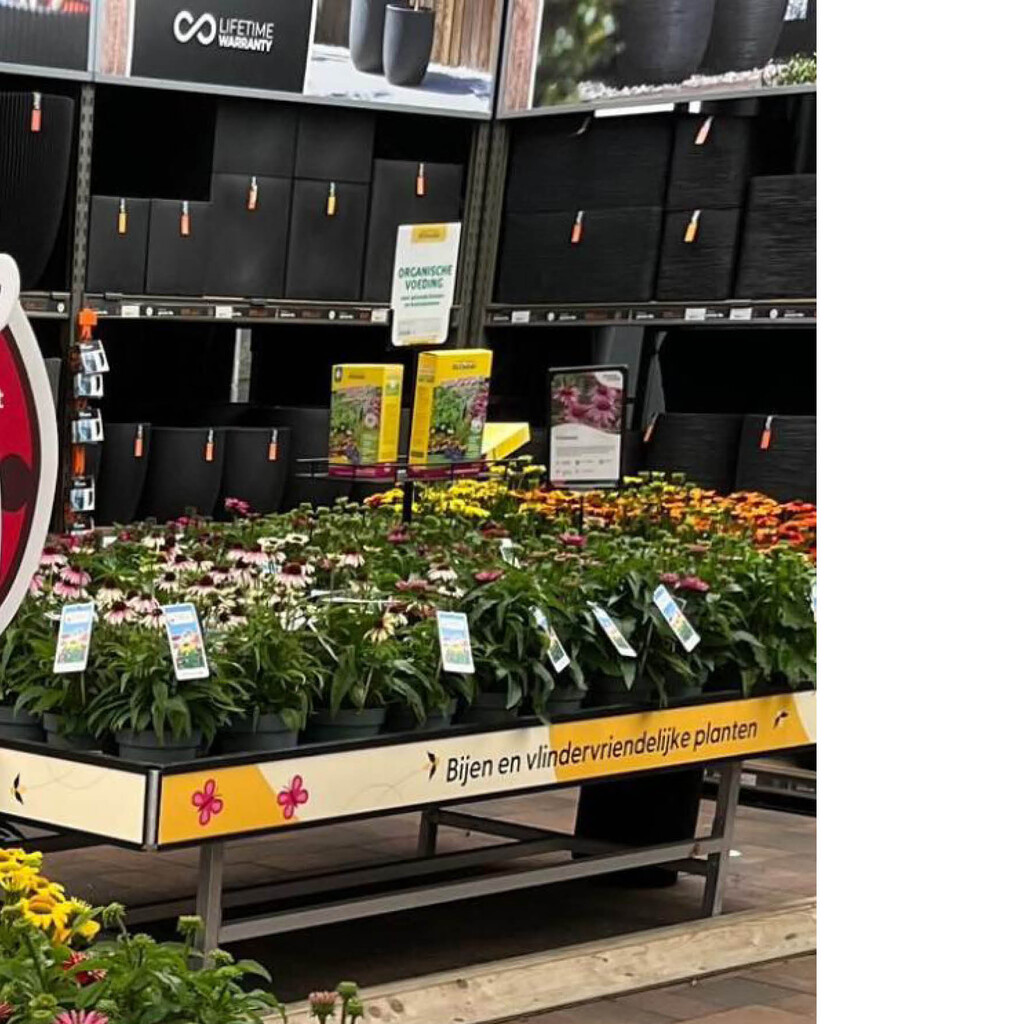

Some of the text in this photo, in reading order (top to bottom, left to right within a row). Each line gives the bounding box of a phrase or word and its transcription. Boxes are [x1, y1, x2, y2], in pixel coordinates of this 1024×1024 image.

[219, 17, 274, 39] LIFETIME
[218, 34, 273, 52] WARRANTY
[398, 264, 453, 279] ORGANISCHE
[405, 277, 444, 290] VOEDING
[446, 719, 758, 787] Bijen en vlindervriendelijke planten
